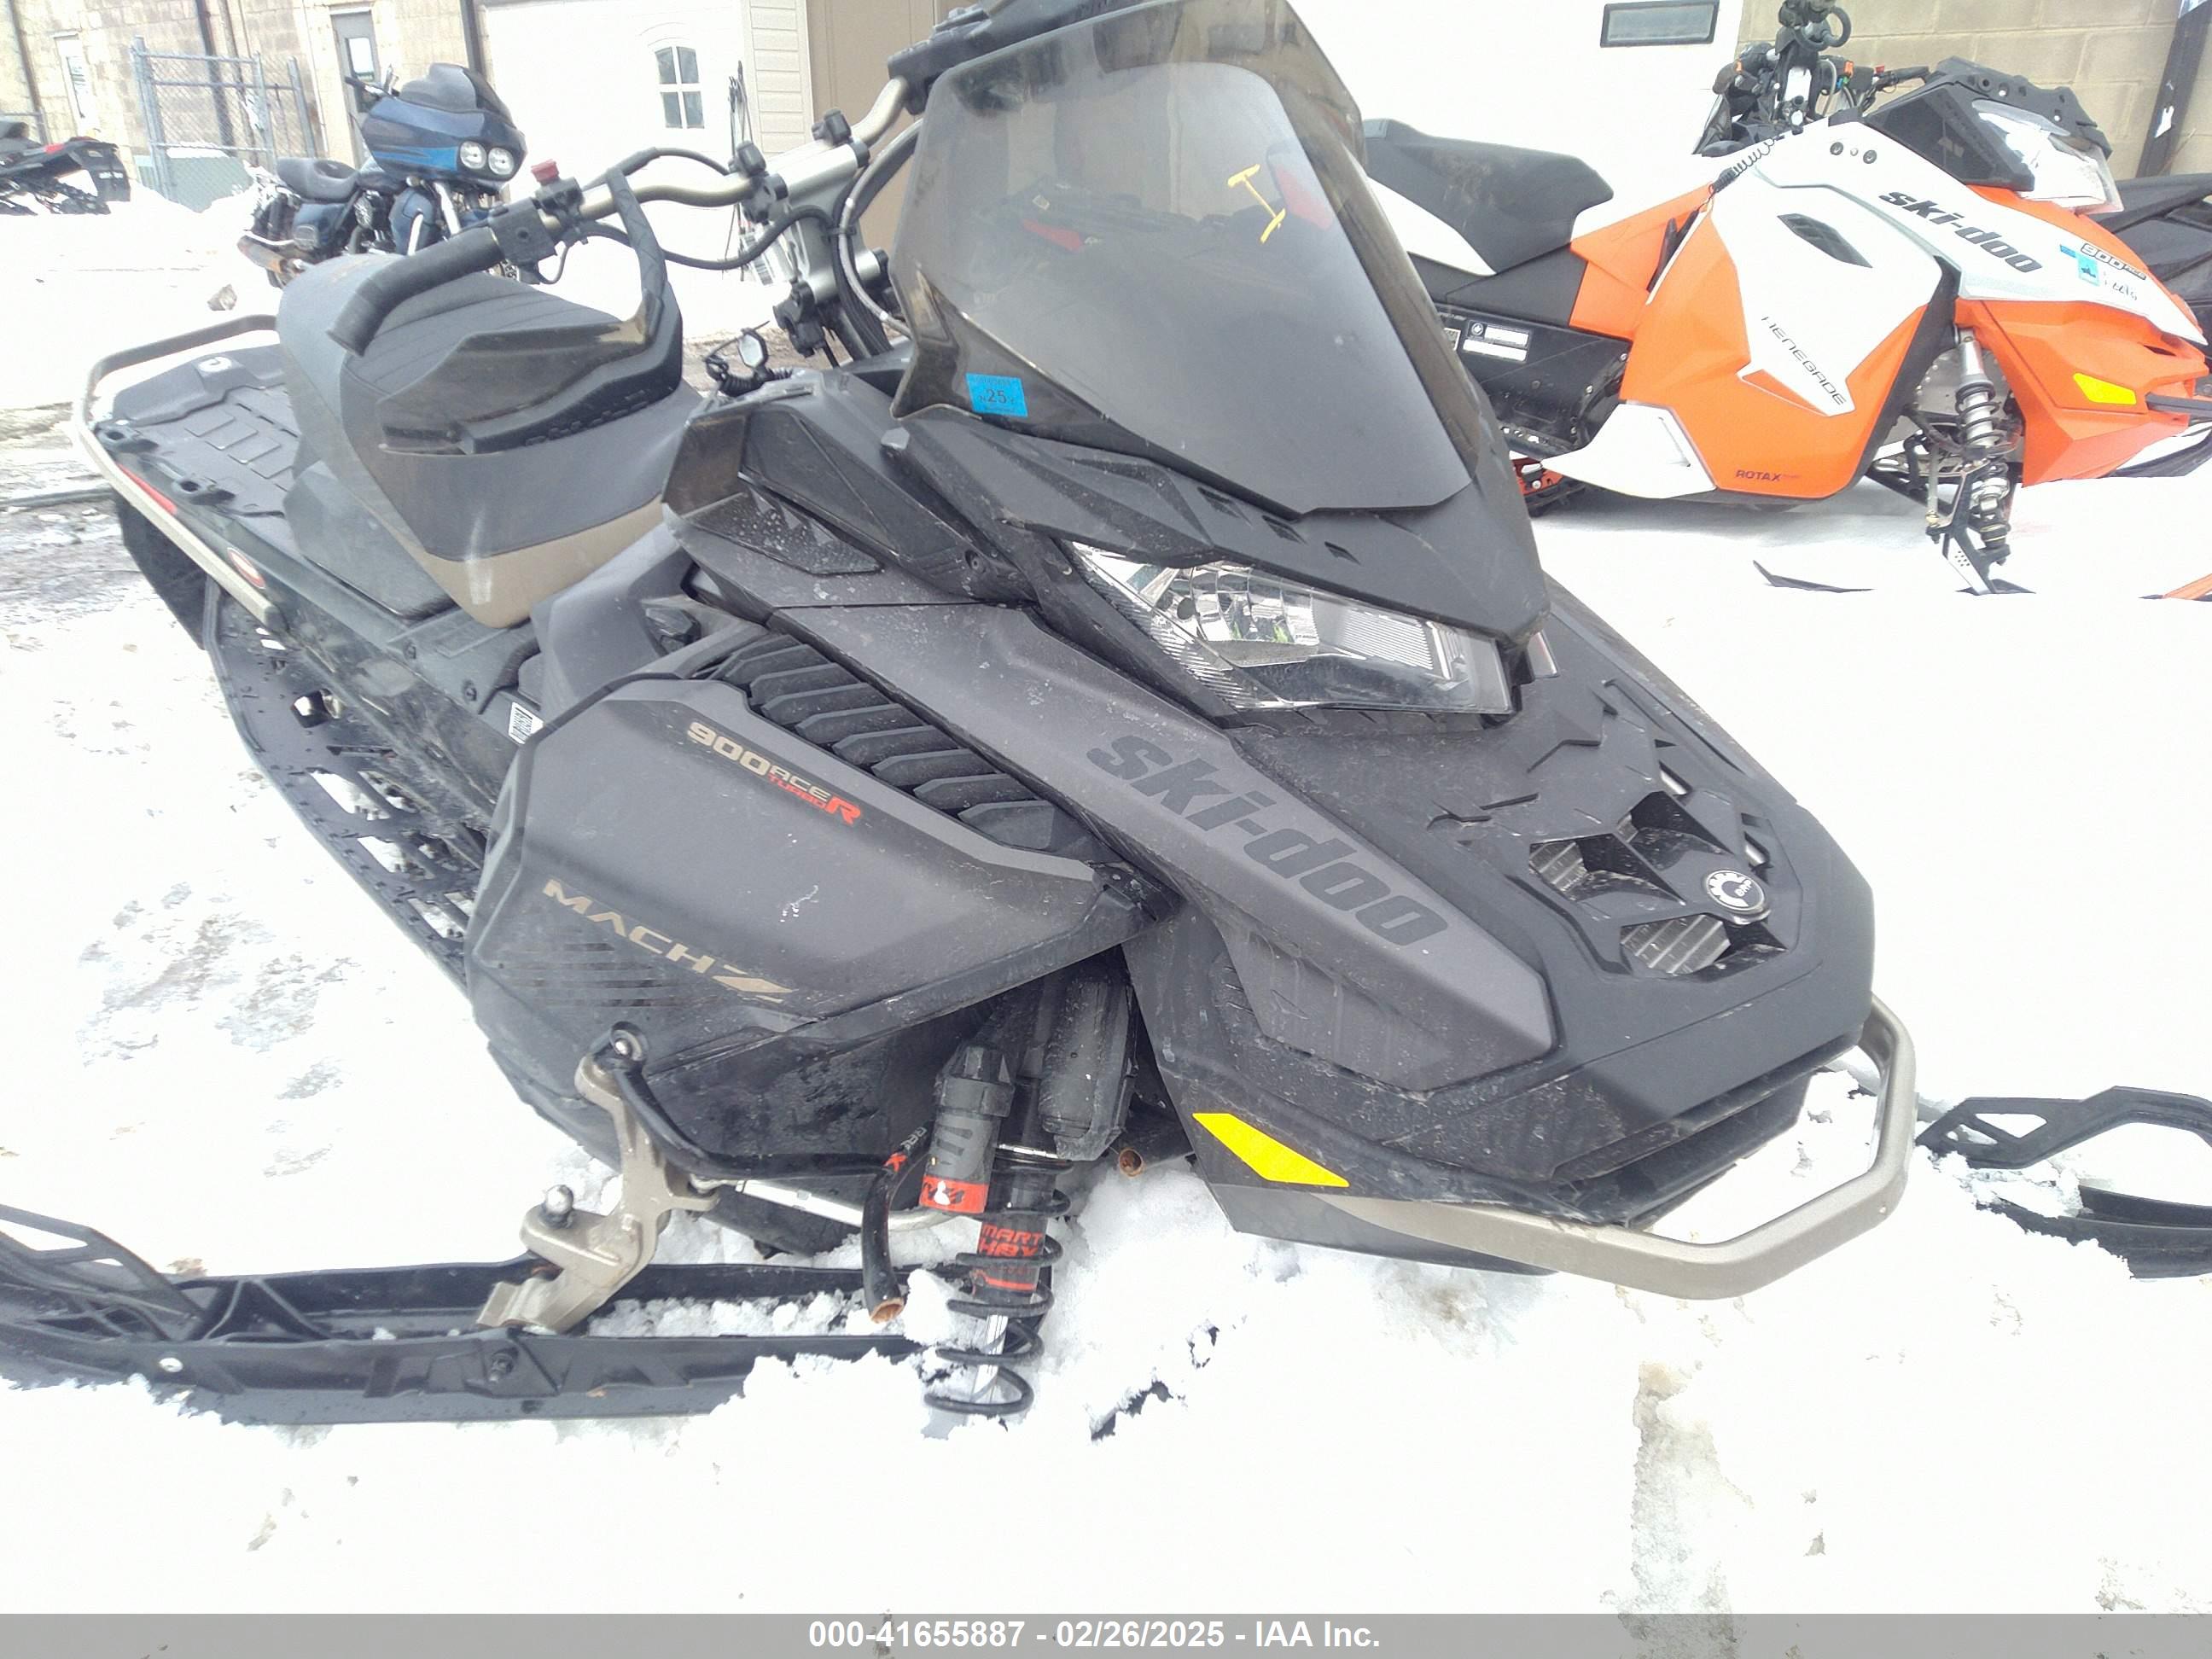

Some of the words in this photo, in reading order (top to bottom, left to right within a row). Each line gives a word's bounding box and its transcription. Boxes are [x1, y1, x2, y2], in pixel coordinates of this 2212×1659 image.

[2081, 243, 2125, 271] 900
[987, 388, 1007, 404] 25
[1735, 469, 1782, 481] ROTAX
[687, 721, 771, 777] 900
[542, 879, 716, 974] MACH
[712, 963, 797, 1004] Z
